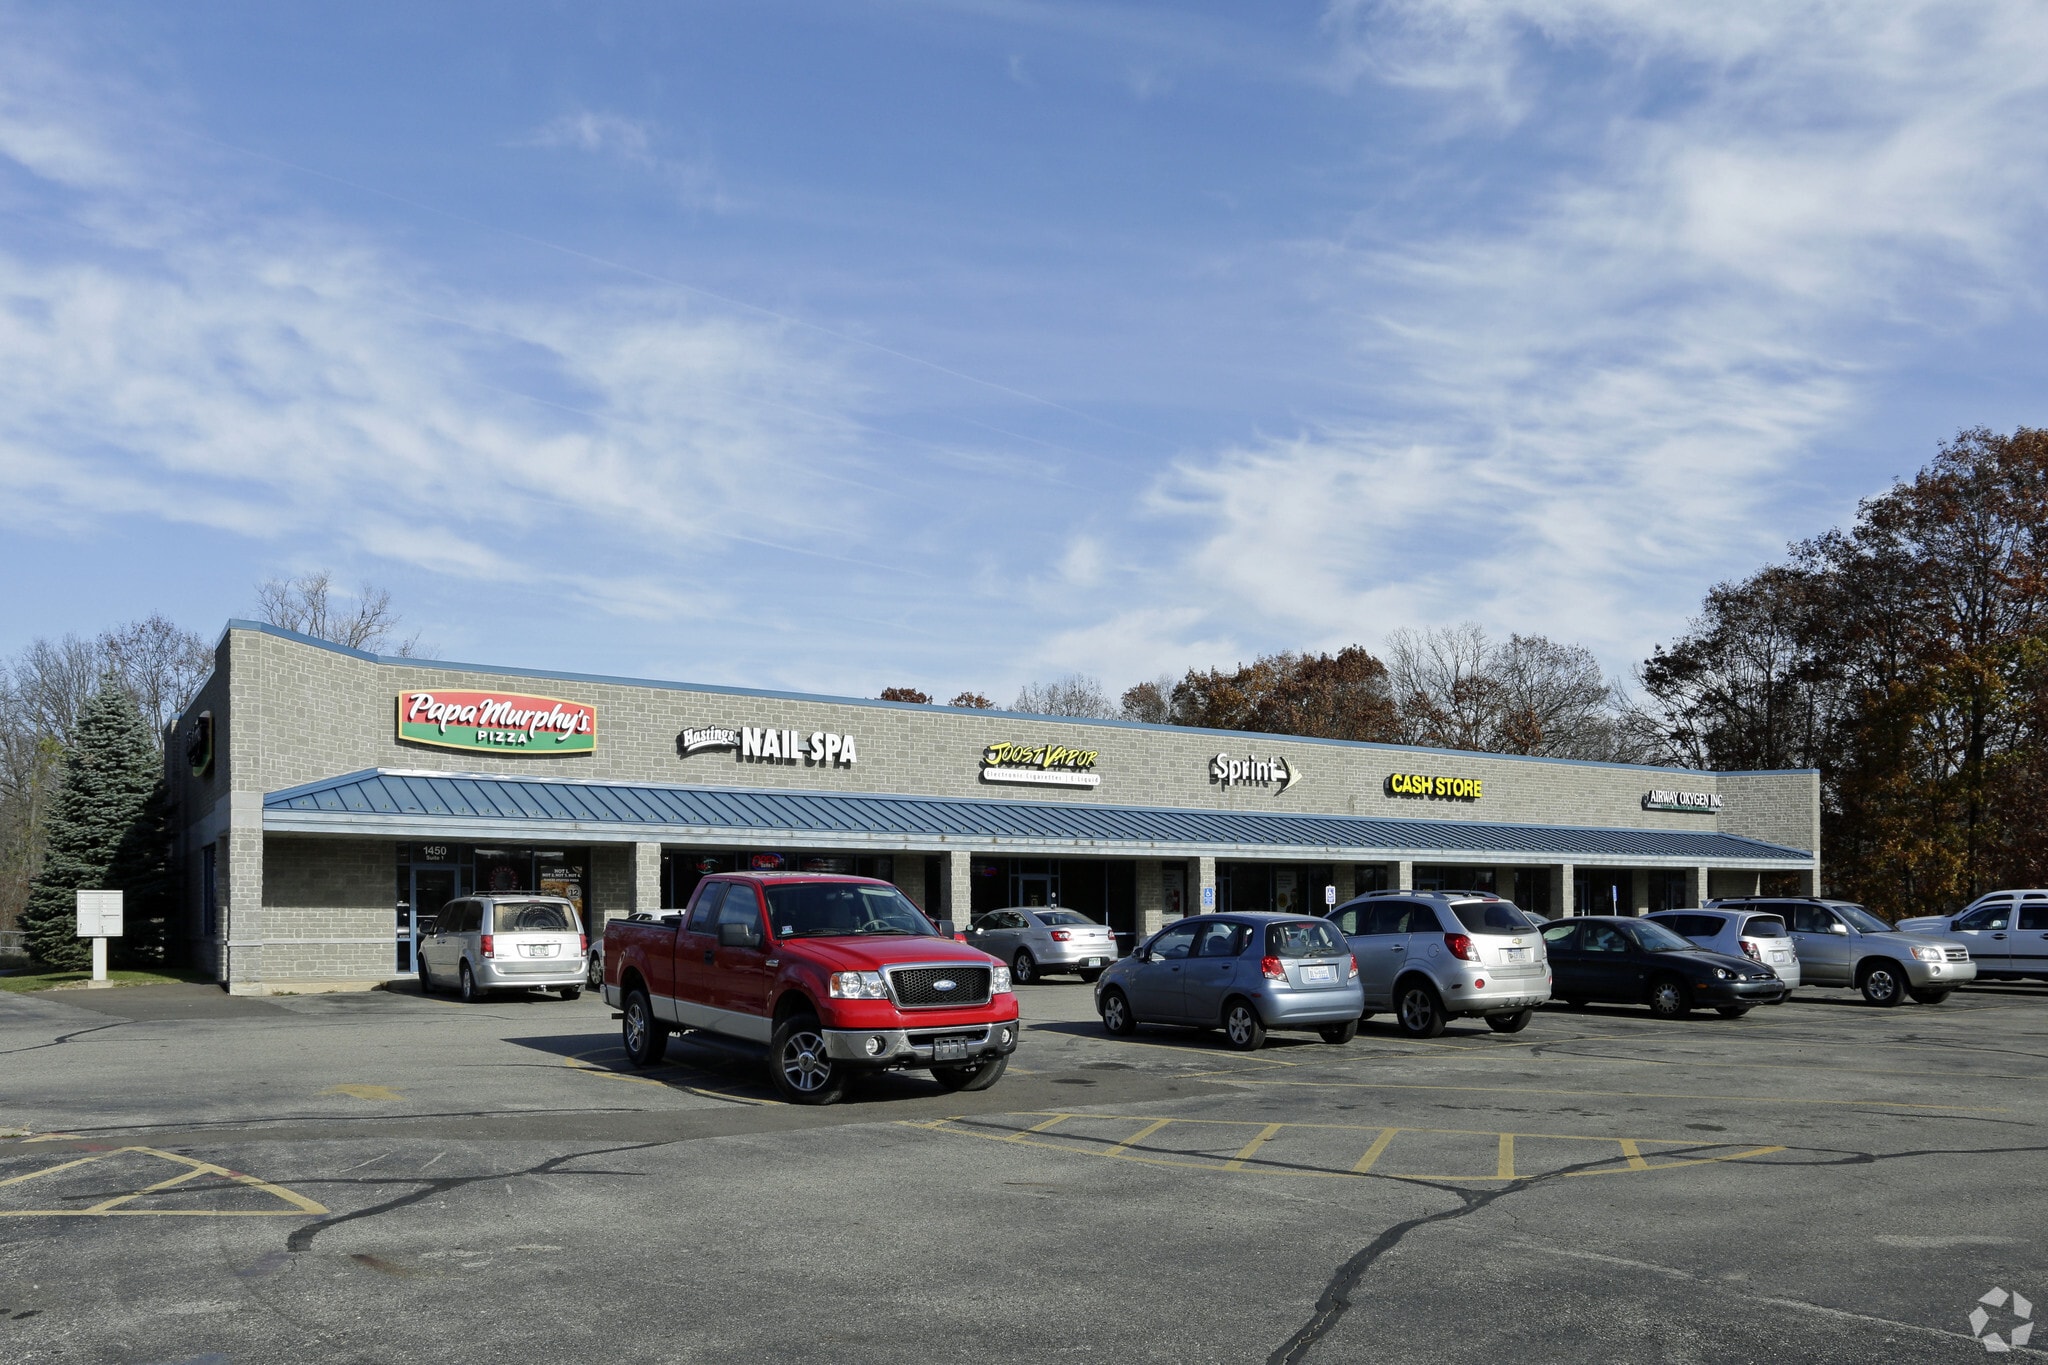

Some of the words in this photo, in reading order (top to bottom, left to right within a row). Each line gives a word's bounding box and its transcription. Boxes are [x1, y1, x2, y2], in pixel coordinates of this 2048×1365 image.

[410, 693, 478, 733] Papa
[479, 699, 590, 741] Murphy's
[477, 731, 527, 744] PIZZA
[683, 725, 735, 748] Hastings
[741, 726, 803, 759] NAIL
[810, 731, 857, 763] SPA
[1043, 744, 1098, 768] VAPOR
[1217, 753, 1278, 786] Sprint
[1392, 773, 1432, 794] CASH
[1435, 777, 1483, 797] STORE
[1651, 790, 1678, 804] AIRWAY
[1680, 791, 1709, 806] OXYGEN
[1710, 794, 1725, 807] INC.
[423, 846, 447, 855] 1450
